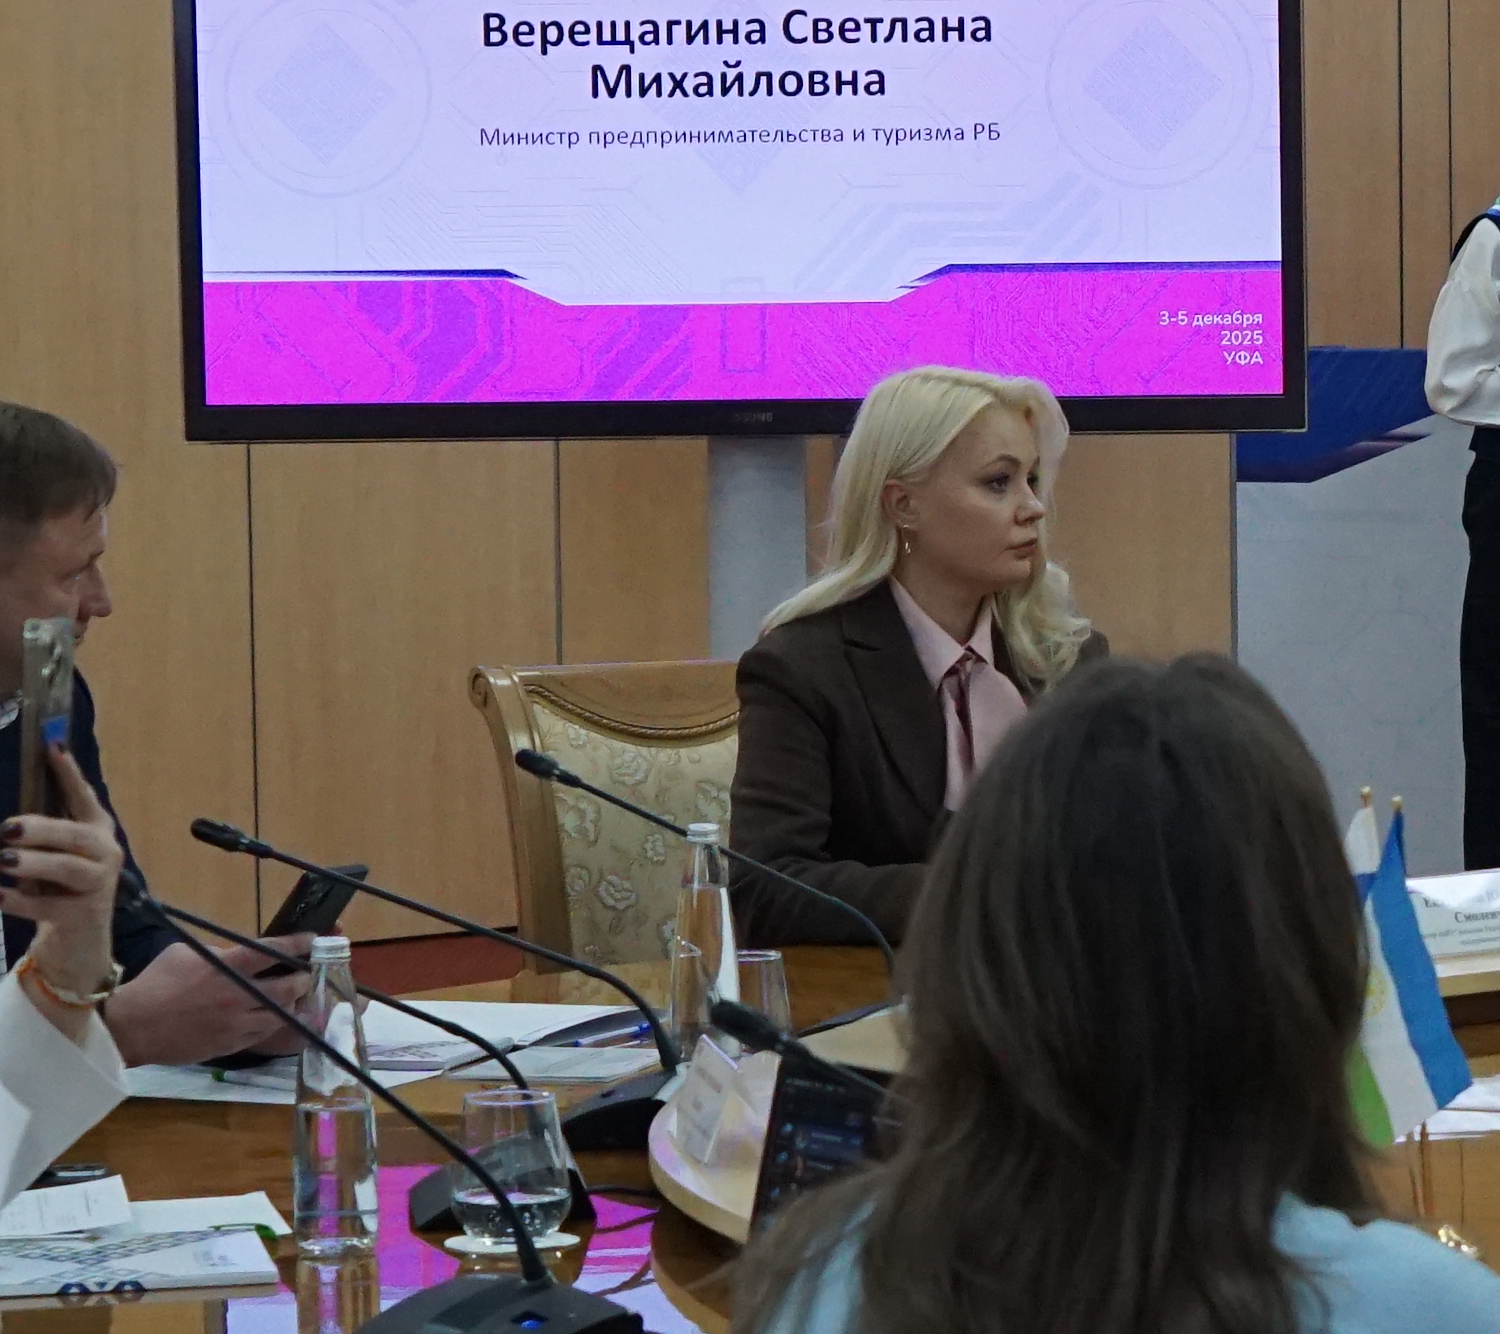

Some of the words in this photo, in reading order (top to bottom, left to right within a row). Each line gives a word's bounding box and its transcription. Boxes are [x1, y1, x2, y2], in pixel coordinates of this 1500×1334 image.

[482, 12, 767, 56] Верещагина
[782, 8, 993, 45] Светлана
[590, 59, 887, 99] Михайловна
[479, 127, 580, 149] Министр
[588, 128, 845, 149] предпринимательства
[852, 128, 866, 143] и
[871, 126, 965, 147] туризма
[973, 122, 1001, 142] РБ
[1159, 310, 1189, 326] 3-5
[1191, 309, 1263, 328] декабря
[1220, 330, 1264, 346] 2025
[1222, 350, 1264, 366] УФА
